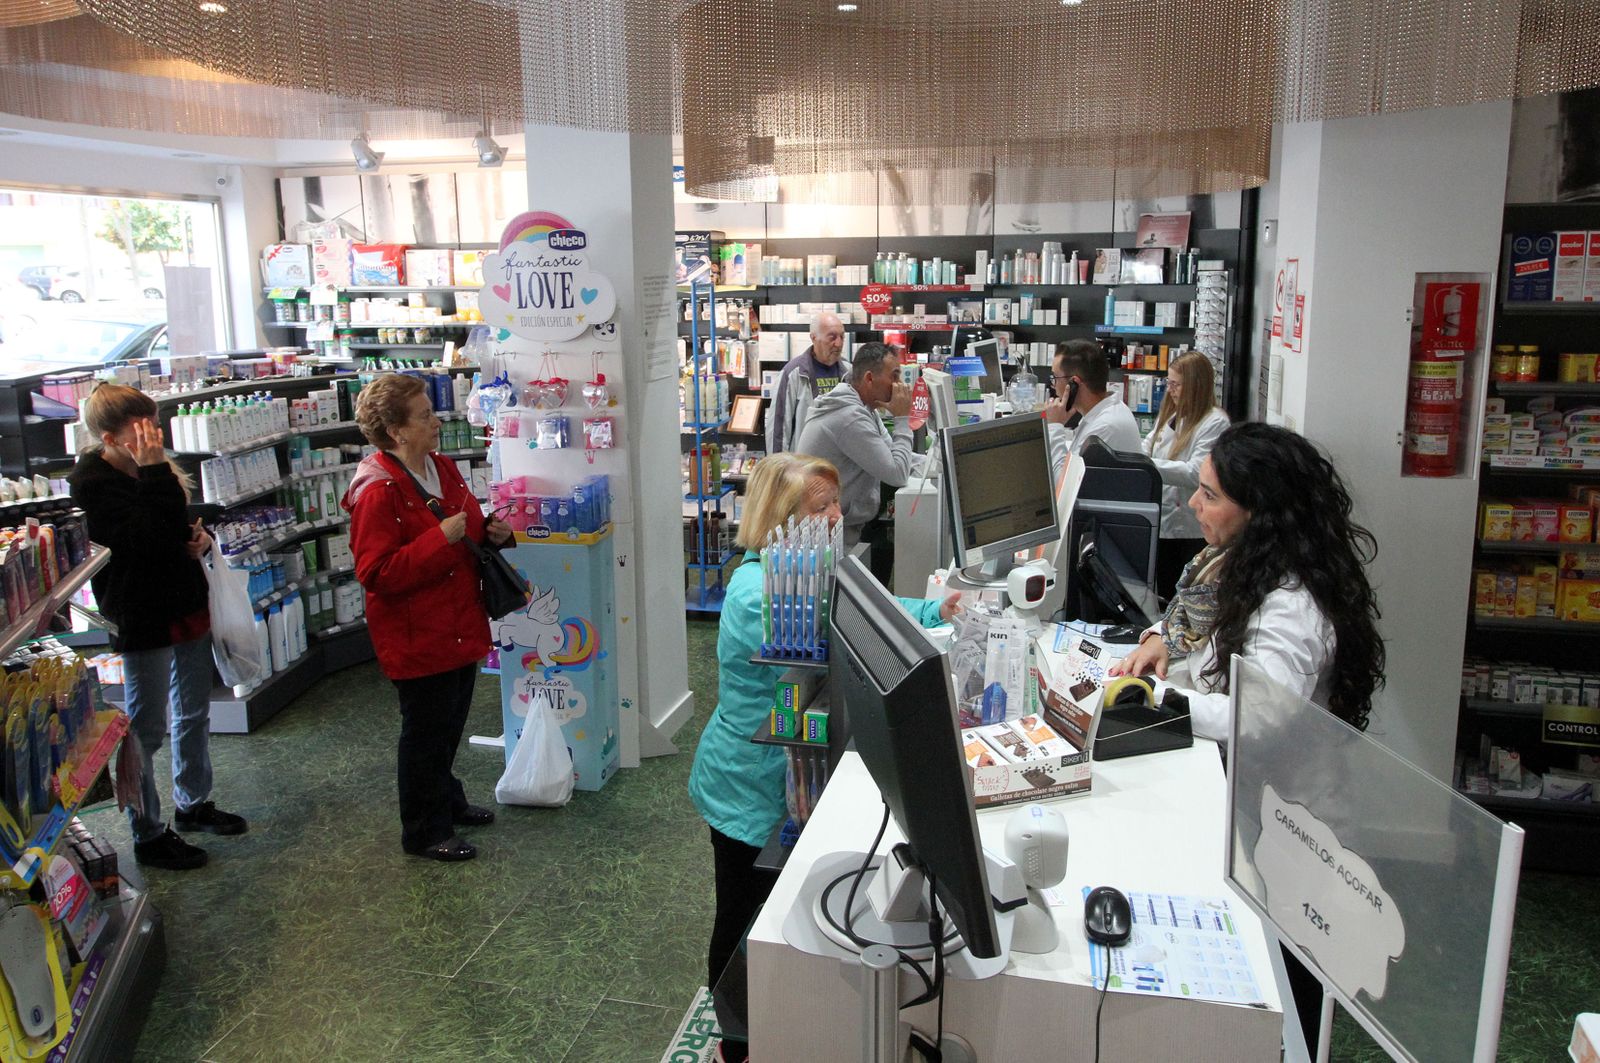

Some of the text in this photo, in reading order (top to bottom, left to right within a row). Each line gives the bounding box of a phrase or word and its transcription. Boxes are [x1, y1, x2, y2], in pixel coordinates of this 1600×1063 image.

[550, 231, 584, 247] chicco
[516, 271, 574, 309] LOVE
[862, 294, 889, 303] -50%
[912, 396, 928, 411] -50%
[1548, 722, 1598, 735] CONTROL
[1275, 809, 1335, 869] CARAMELOS
